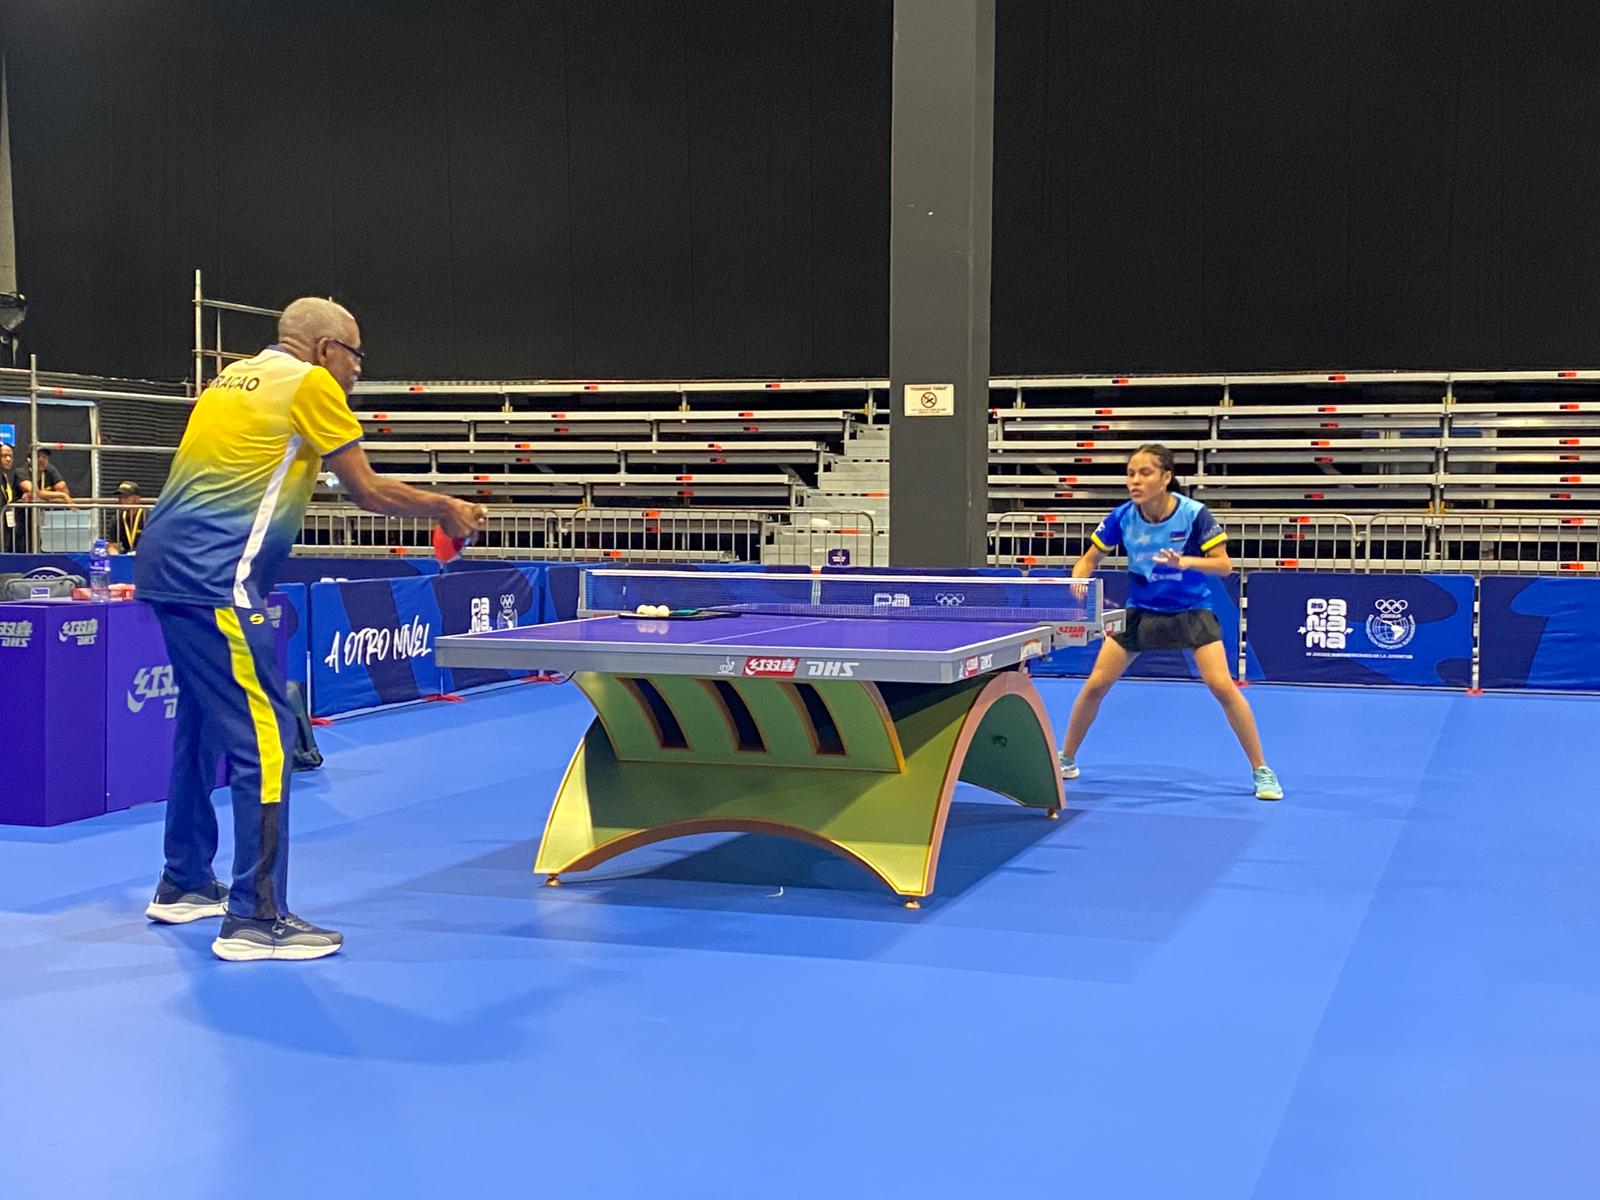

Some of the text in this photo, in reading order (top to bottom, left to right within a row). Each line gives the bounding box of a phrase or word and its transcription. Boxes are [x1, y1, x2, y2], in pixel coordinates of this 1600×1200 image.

[324, 631, 340, 674] A
[344, 627, 390, 666] OTRO
[806, 660, 860, 677] DHS
